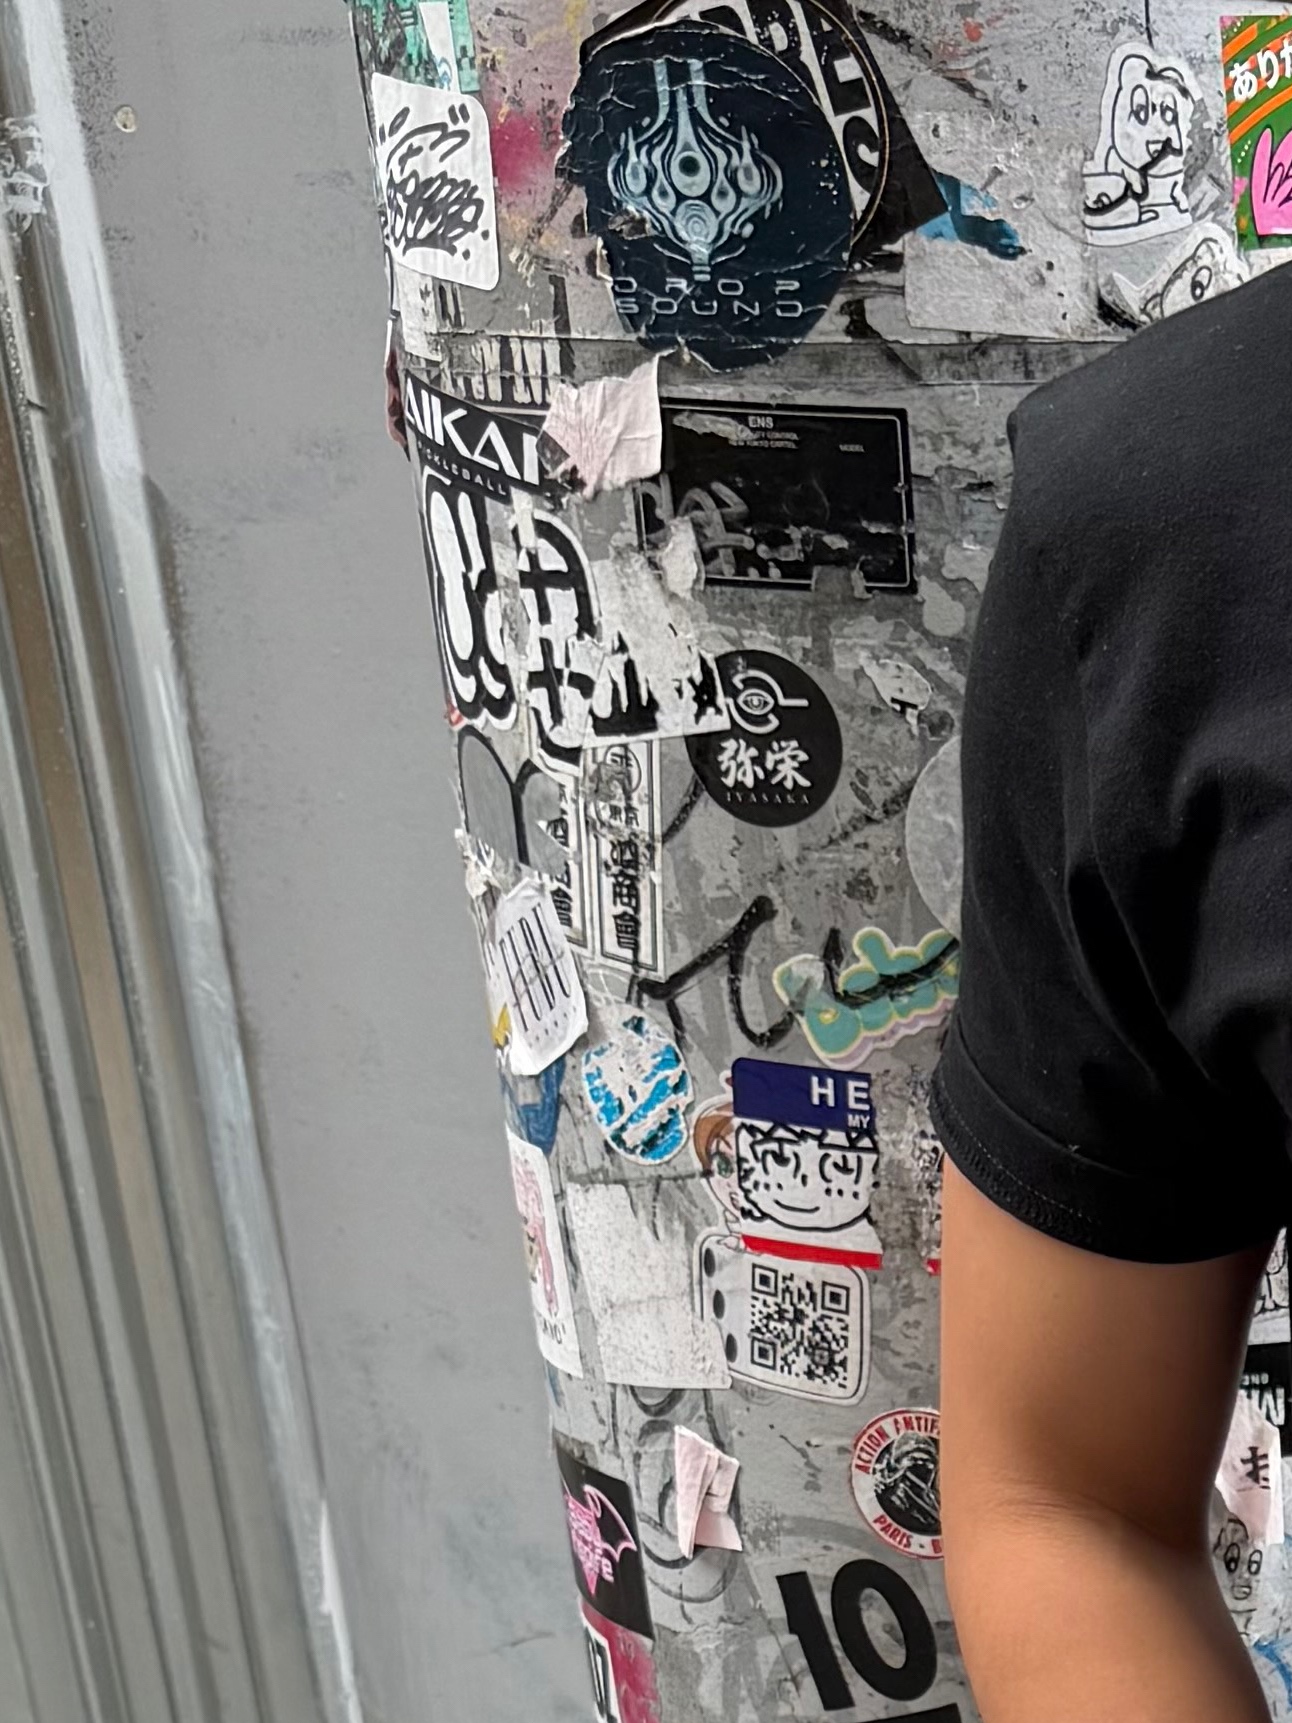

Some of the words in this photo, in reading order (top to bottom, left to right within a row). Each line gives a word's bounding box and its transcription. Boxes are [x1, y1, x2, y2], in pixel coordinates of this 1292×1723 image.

[614, 276, 801, 296] DROP
[615, 297, 803, 318] SOUND
[717, 738, 812, 790] 弥栄
[854, 1424, 890, 1475] ACTION
[893, 1415, 941, 1435] ANTIF
[872, 1513, 914, 1549] PARIS
[776, 1558, 938, 1711] 10
